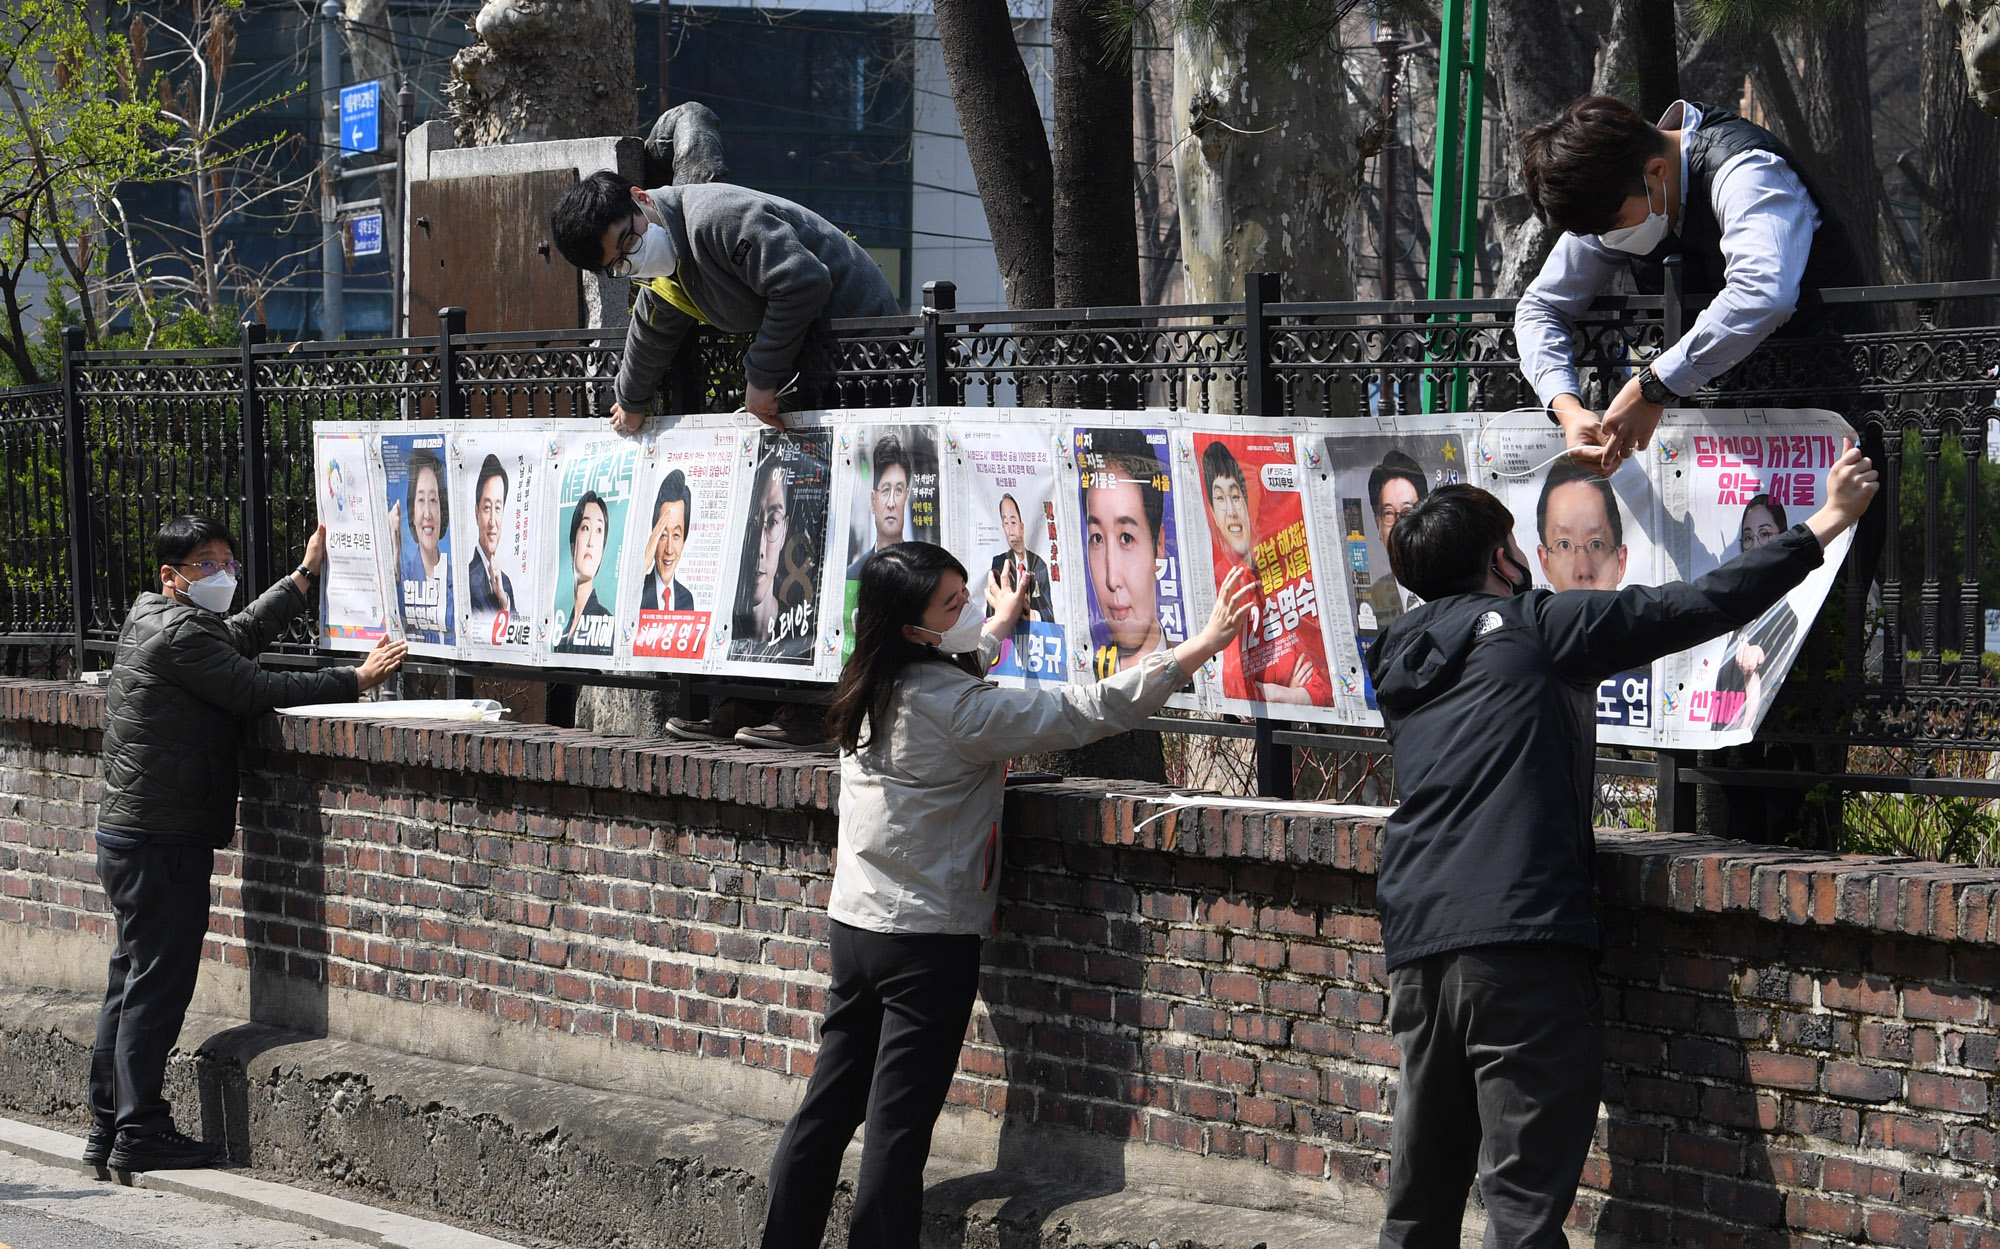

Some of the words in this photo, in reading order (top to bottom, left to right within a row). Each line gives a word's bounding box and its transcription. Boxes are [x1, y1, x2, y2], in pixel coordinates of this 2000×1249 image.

[776, 443, 801, 461] 서울은
[1076, 433, 1093, 450] 여자
[1694, 436, 1764, 468] 당신의
[1767, 436, 1836, 468] 자리가
[772, 466, 796, 485] 이기는
[1077, 452, 1106, 468] 혼자도
[1081, 472, 1117, 489] 살기좋은
[1152, 474, 1171, 492] 서울
[1267, 477, 1295, 488] 지지후보
[1717, 473, 1760, 505] 있는
[1767, 473, 1816, 506] 서울
[329, 531, 352, 549] 선거벽보
[353, 532, 371, 551] 주의문
[1253, 537, 1278, 570] 강남
[1278, 520, 1307, 555] 해체!
[1261, 566, 1285, 596] 평등
[1285, 549, 1312, 582] 서울!
[403, 579, 440, 607] 합니다
[767, 599, 814, 648] 오태양
[1262, 577, 1318, 643] 송명숙
[492, 610, 510, 646] 2
[506, 624, 531, 646] 오세훈
[552, 609, 566, 647] 6
[573, 614, 615, 648] 신지혜
[692, 623, 706, 654] 7
[1241, 605, 1260, 653] 12
[1014, 633, 1062, 675] 배영규
[1096, 645, 1117, 679] 11
[1596, 678, 1649, 727] 도엽
[1688, 690, 1748, 725] 신지예
